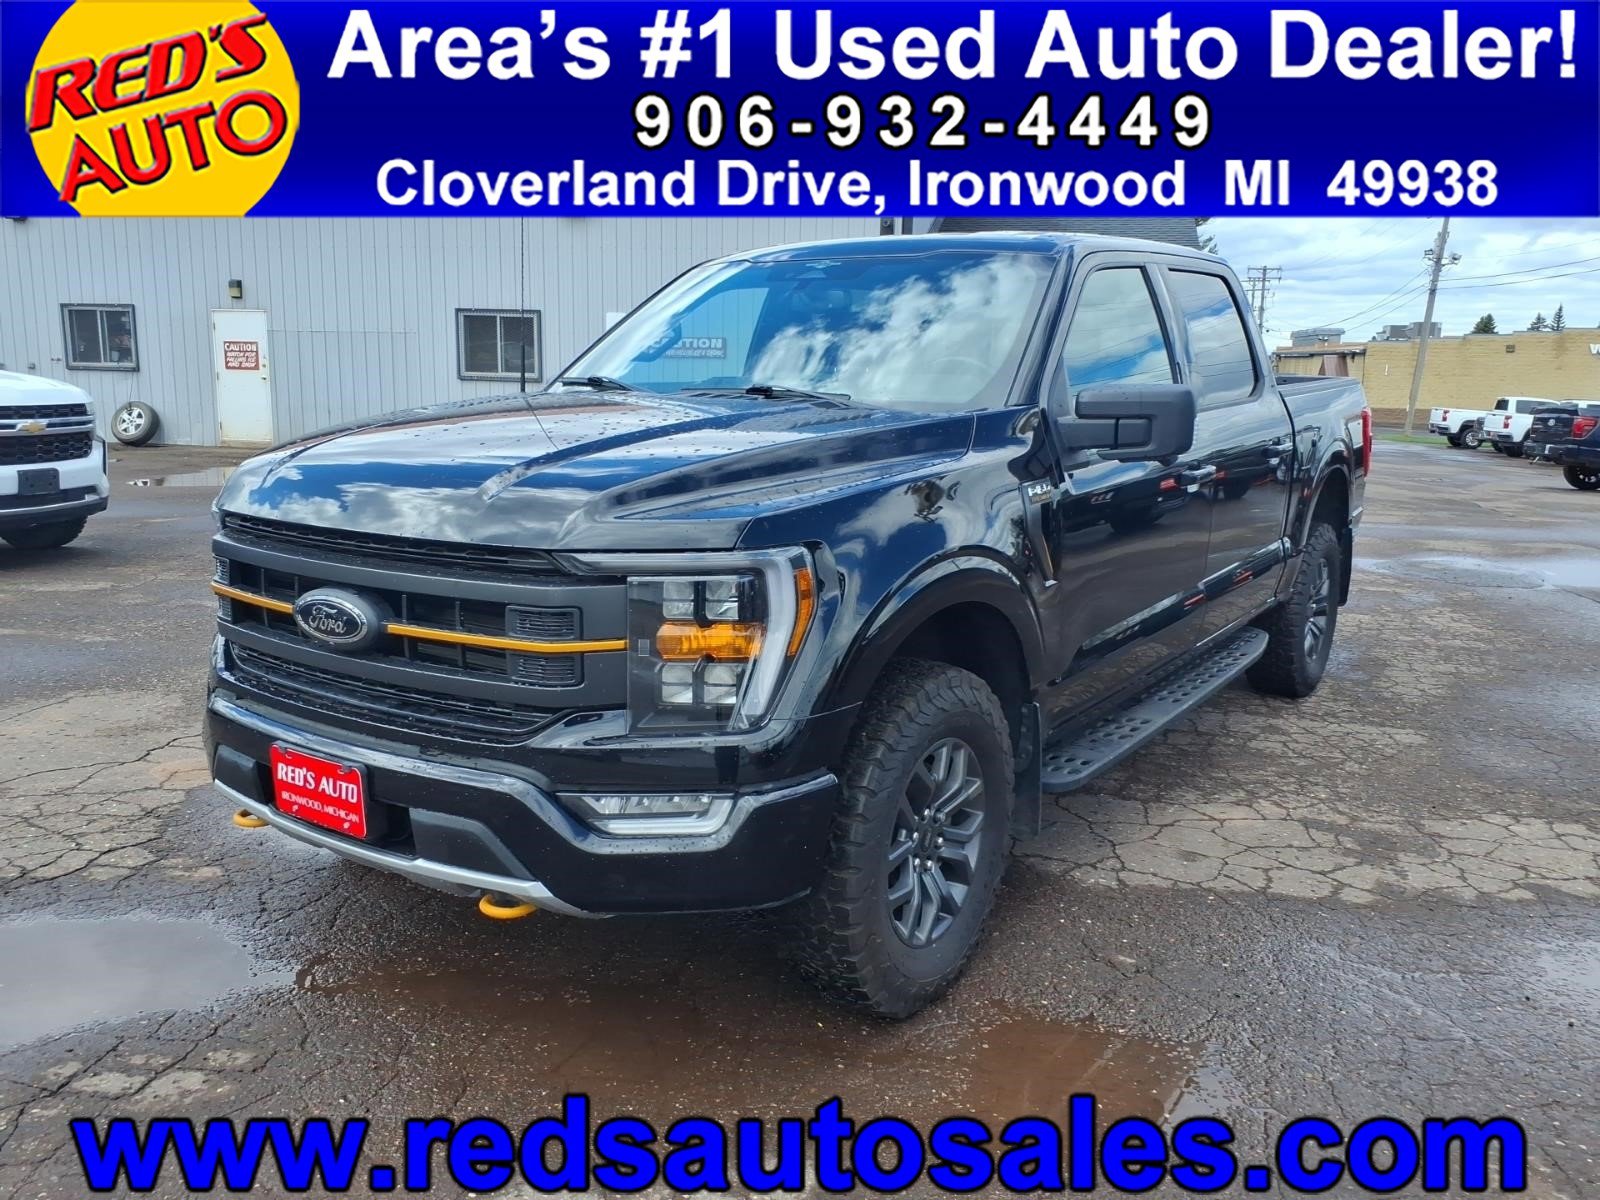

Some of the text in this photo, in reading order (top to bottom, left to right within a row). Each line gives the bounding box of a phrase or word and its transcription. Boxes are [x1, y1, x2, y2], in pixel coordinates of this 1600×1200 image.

[224, 343, 256, 351] CAUTION
[308, 604, 347, 634] Ford
[277, 762, 358, 804] RED'S AUTO
[323, 803, 360, 824] MICHIGAN
